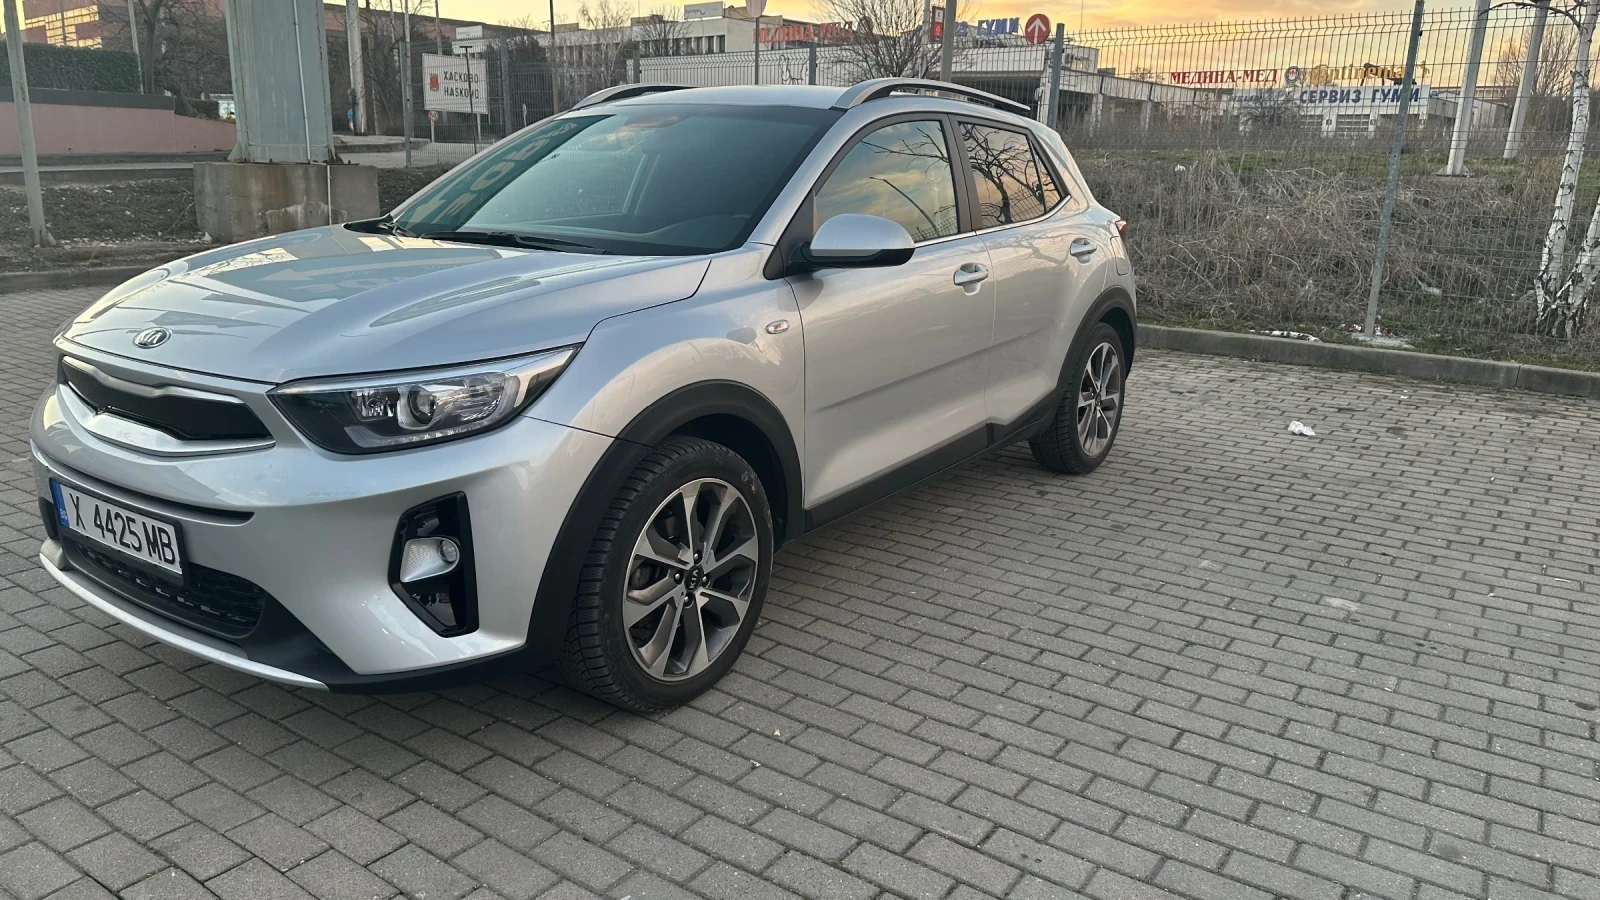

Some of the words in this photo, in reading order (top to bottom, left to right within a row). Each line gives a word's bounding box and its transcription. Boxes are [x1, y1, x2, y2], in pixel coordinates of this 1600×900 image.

[443, 70, 479, 84] ХАСКОВО
[1169, 69, 1278, 85] МЕДИНА-МЕД
[1310, 64, 1406, 85] Continenta
[1300, 88, 1361, 104] СЕРВИЗ
[135, 329, 164, 345] KIA
[93, 503, 142, 553] 4425
[688, 569, 699, 589] KIA
